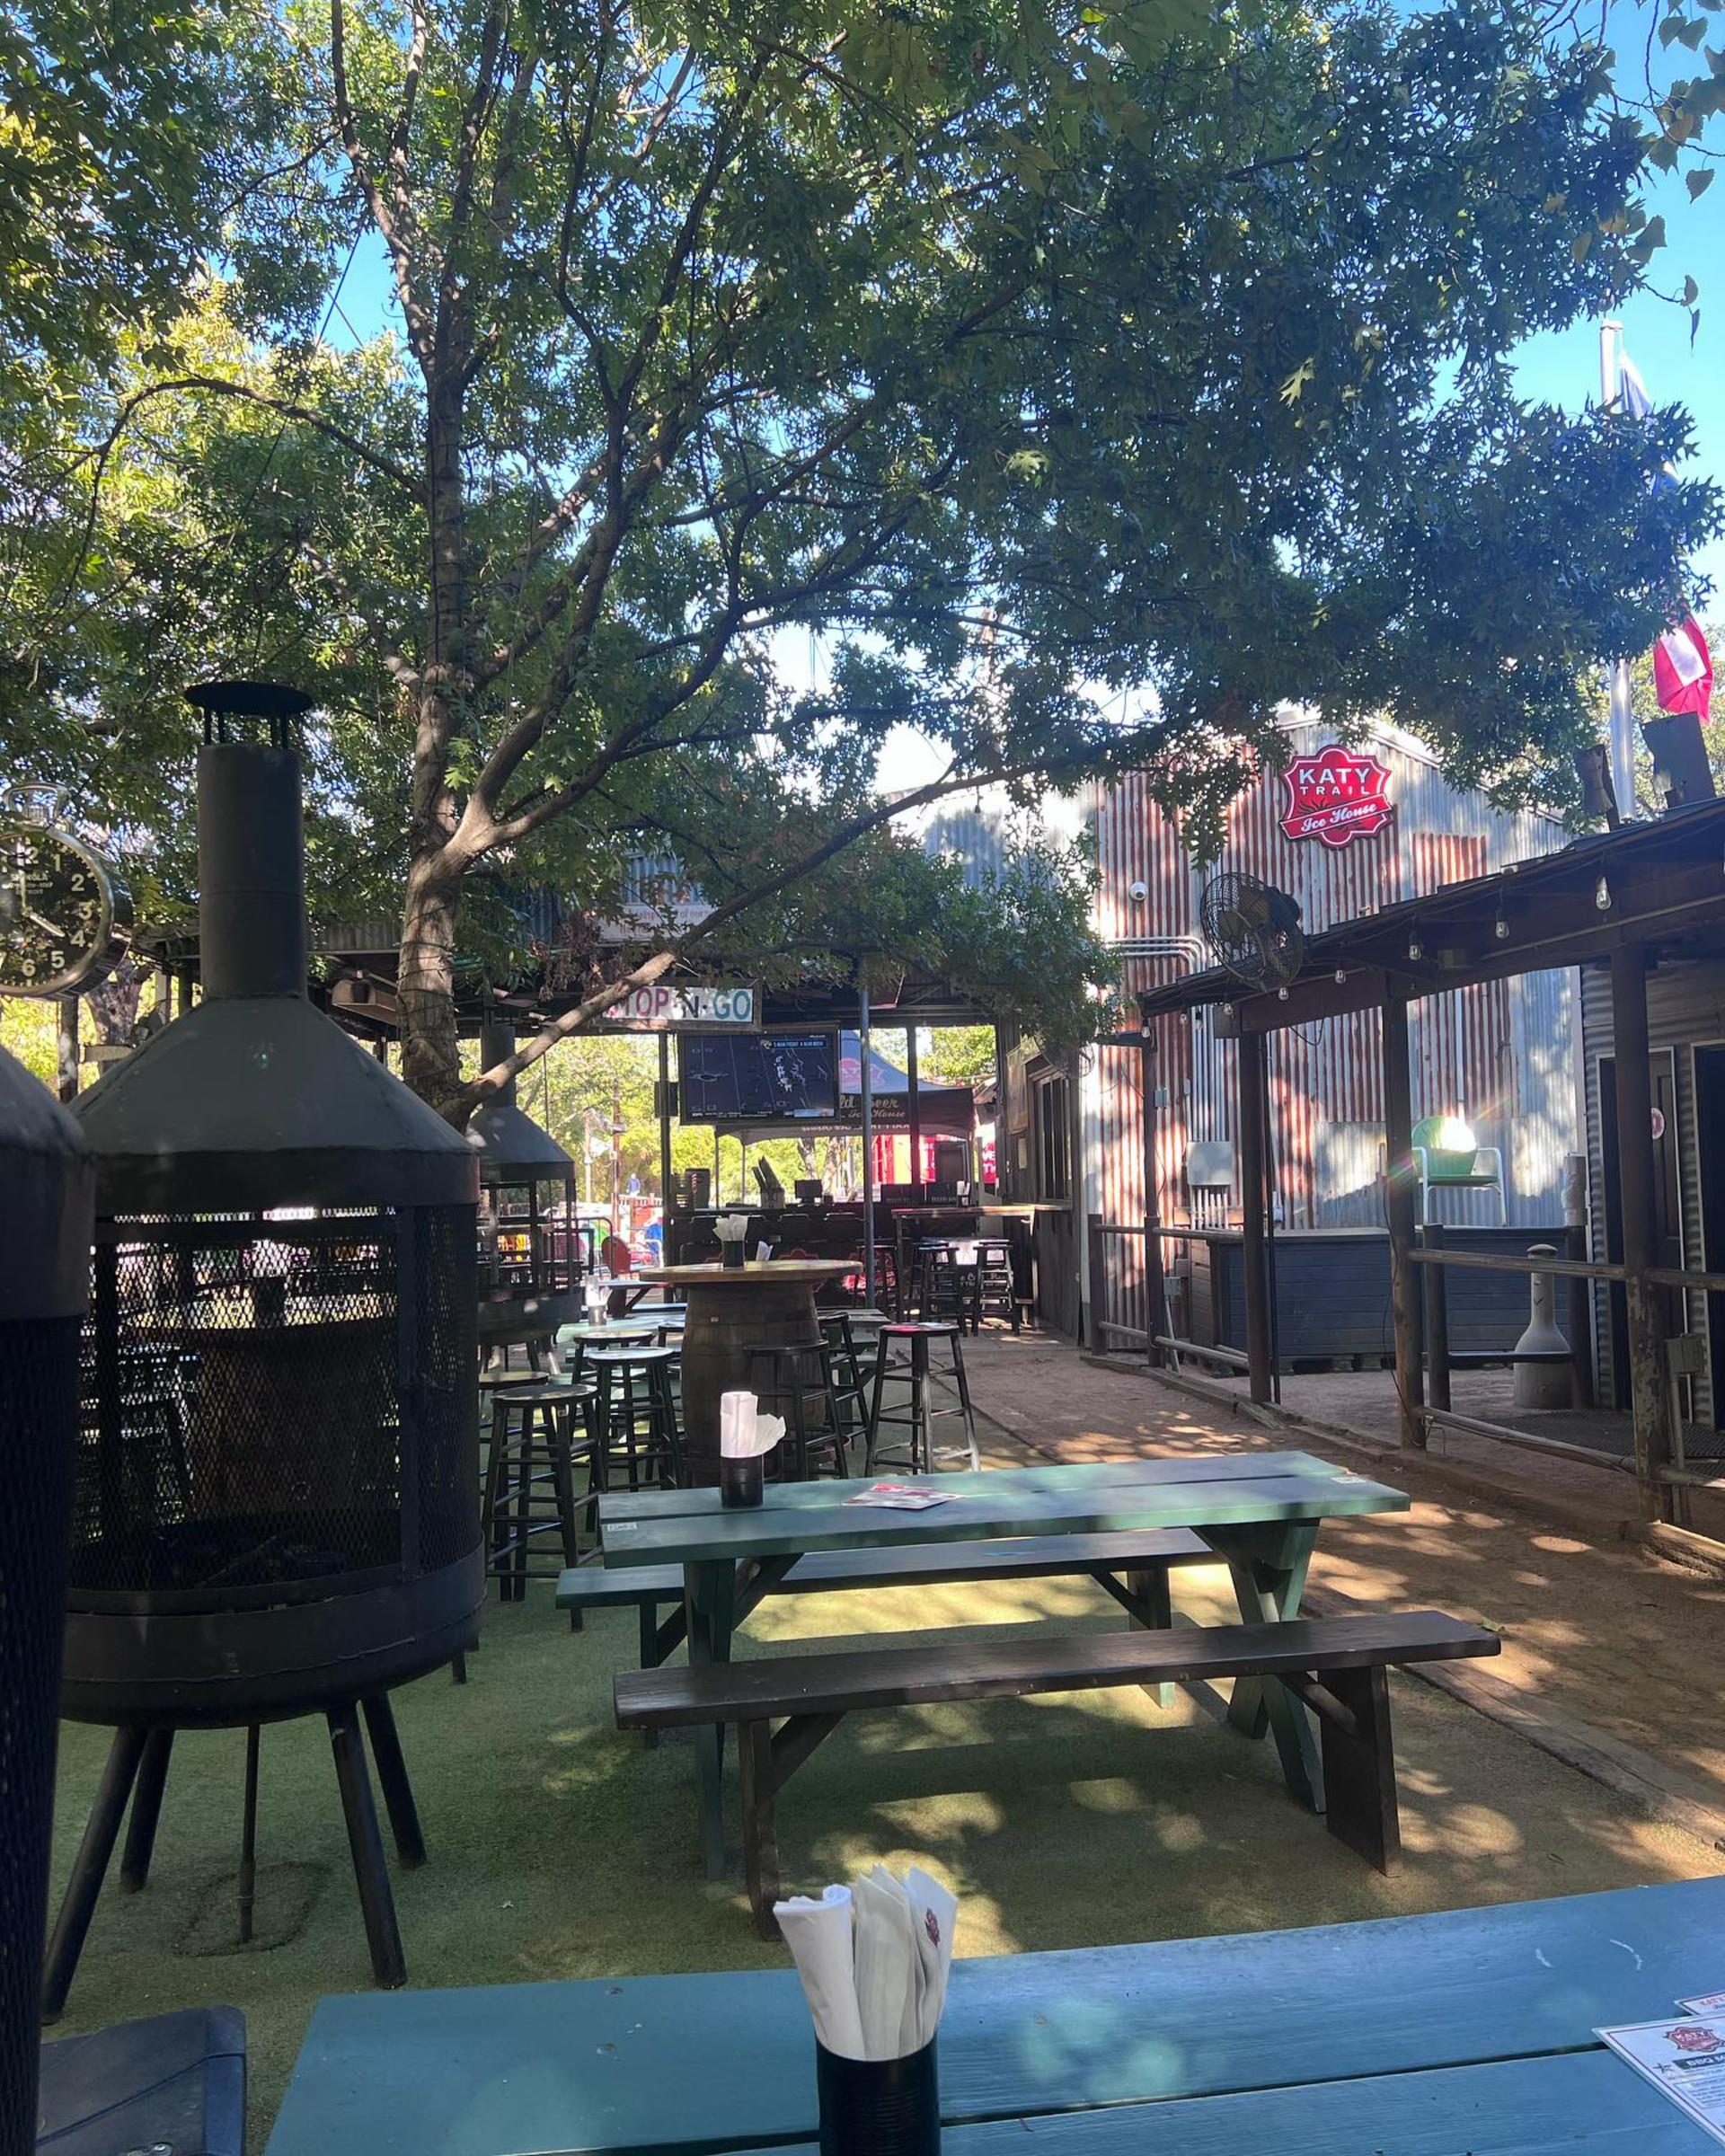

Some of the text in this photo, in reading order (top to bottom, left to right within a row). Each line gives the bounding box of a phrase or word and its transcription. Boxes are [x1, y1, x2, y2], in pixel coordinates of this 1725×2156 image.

[1298, 767, 1370, 784] KATY
[1299, 786, 1370, 795] TRAIL
[1301, 802, 1378, 832] Ice House
[71, 873, 85, 892] 2
[70, 930, 86, 948] 4
[22, 959, 37, 977] 6
[50, 950, 66, 969] 5
[713, 990, 751, 1020] GO
